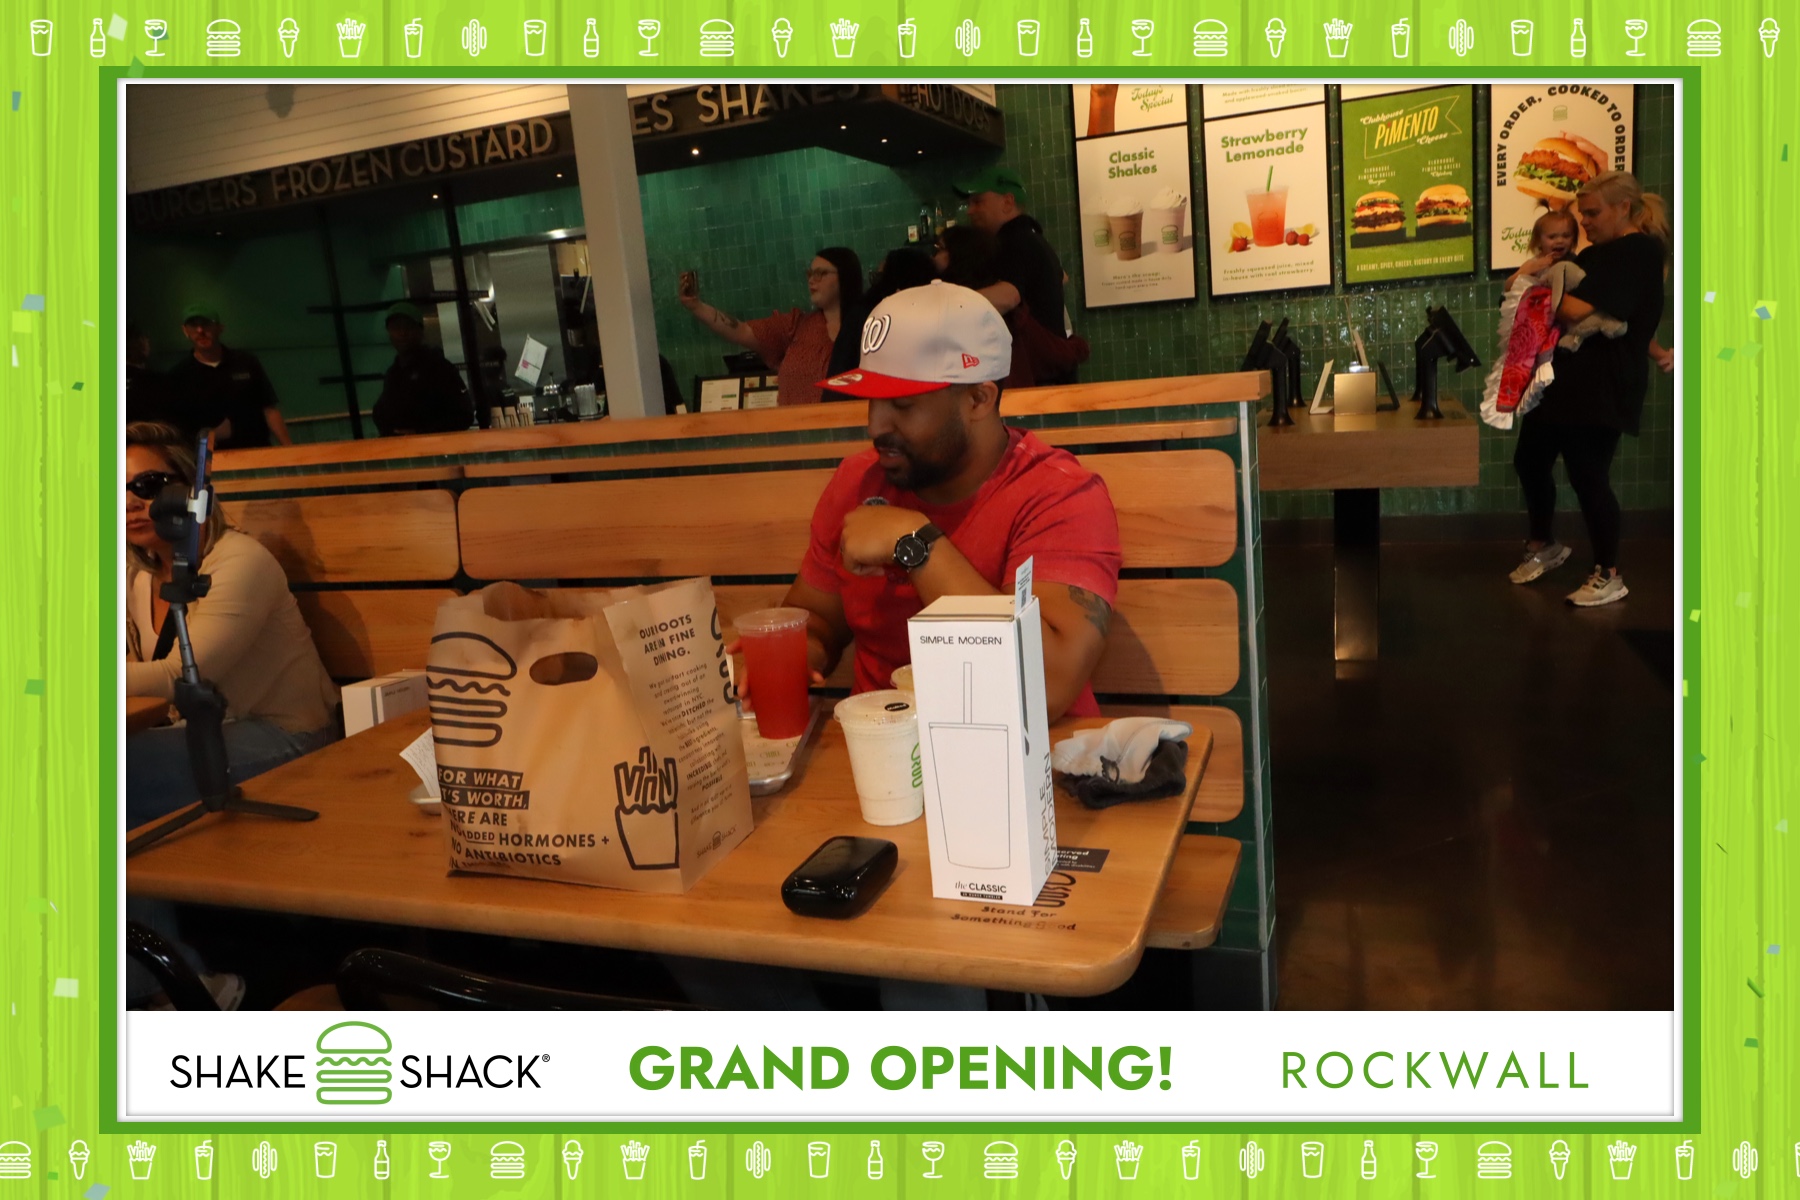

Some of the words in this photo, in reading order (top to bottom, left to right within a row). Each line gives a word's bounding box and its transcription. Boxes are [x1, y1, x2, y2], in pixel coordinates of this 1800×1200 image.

[1140, 94, 1174, 112] Special
[1547, 84, 1610, 106] COOKED
[1360, 109, 1404, 125] Clubhouse
[1499, 95, 1542, 140] ORDER,
[1606, 103, 1622, 122] TO
[1220, 127, 1308, 149] Strawberry
[1416, 132, 1449, 145] Cheese
[1108, 147, 1155, 165] Classic
[1225, 141, 1305, 163] Lemonade
[132, 174, 257, 225] BURGERS
[270, 147, 394, 200] FROZEN
[400, 117, 553, 177] CUSTARD
[1107, 163, 1158, 179] Shakes
[1496, 143, 1507, 187] EVERY
[669, 627, 696, 645] FINE
[919, 635, 954, 645] SIMPLE
[958, 636, 1002, 645] MODERN
[686, 663, 708, 676] cooking
[681, 701, 706, 718] DITCHED
[473, 771, 521, 788] WHAT
[467, 791, 528, 809] WORTH,
[479, 811, 508, 826] ARE
[499, 833, 596, 848] HORMONES
[968, 882, 1007, 893] CLASSIC
[981, 906, 1026, 917] Stand
[950, 913, 1032, 928] Something
[1035, 920, 1077, 931] God
